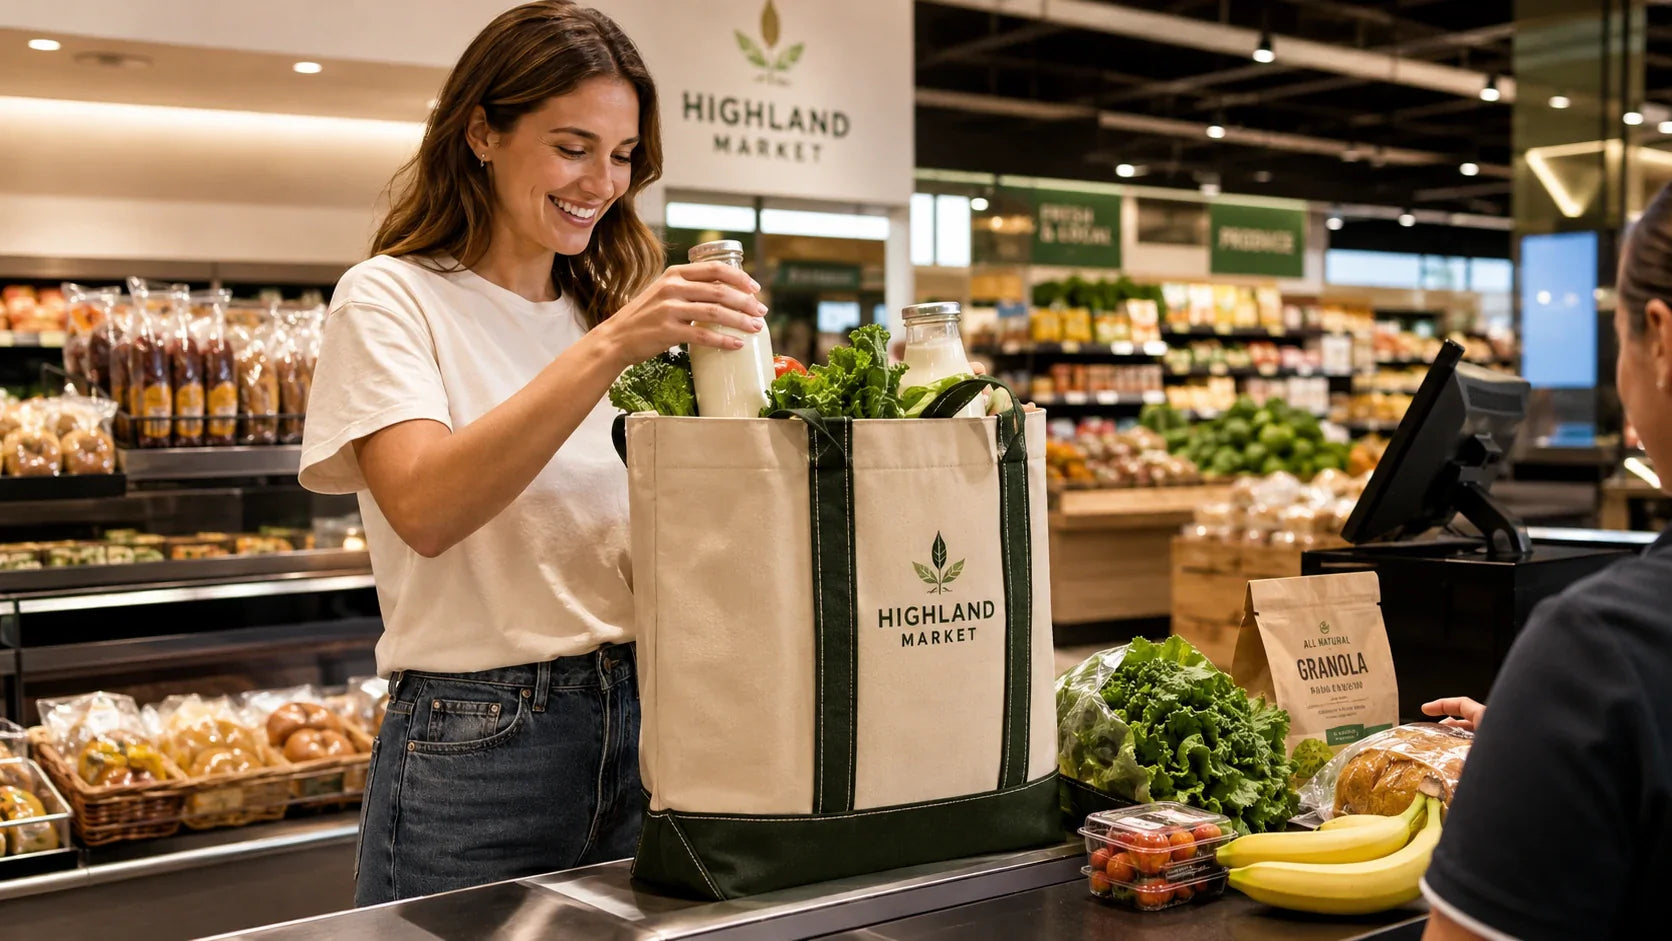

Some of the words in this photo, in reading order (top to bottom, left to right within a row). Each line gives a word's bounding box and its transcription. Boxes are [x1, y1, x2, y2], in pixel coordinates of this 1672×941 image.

[682, 91, 850, 138] HIGHLAND
[713, 134, 822, 163] MARKET
[1057, 226, 1111, 246] LOCAL
[1218, 225, 1295, 255] PRODUCE
[878, 600, 995, 628] HIGHLAND
[901, 627, 977, 647] MARKET
[1303, 639, 1317, 649] ALL
[1318, 635, 1350, 647] NATURAL
[1297, 652, 1369, 681] GRANOLA
